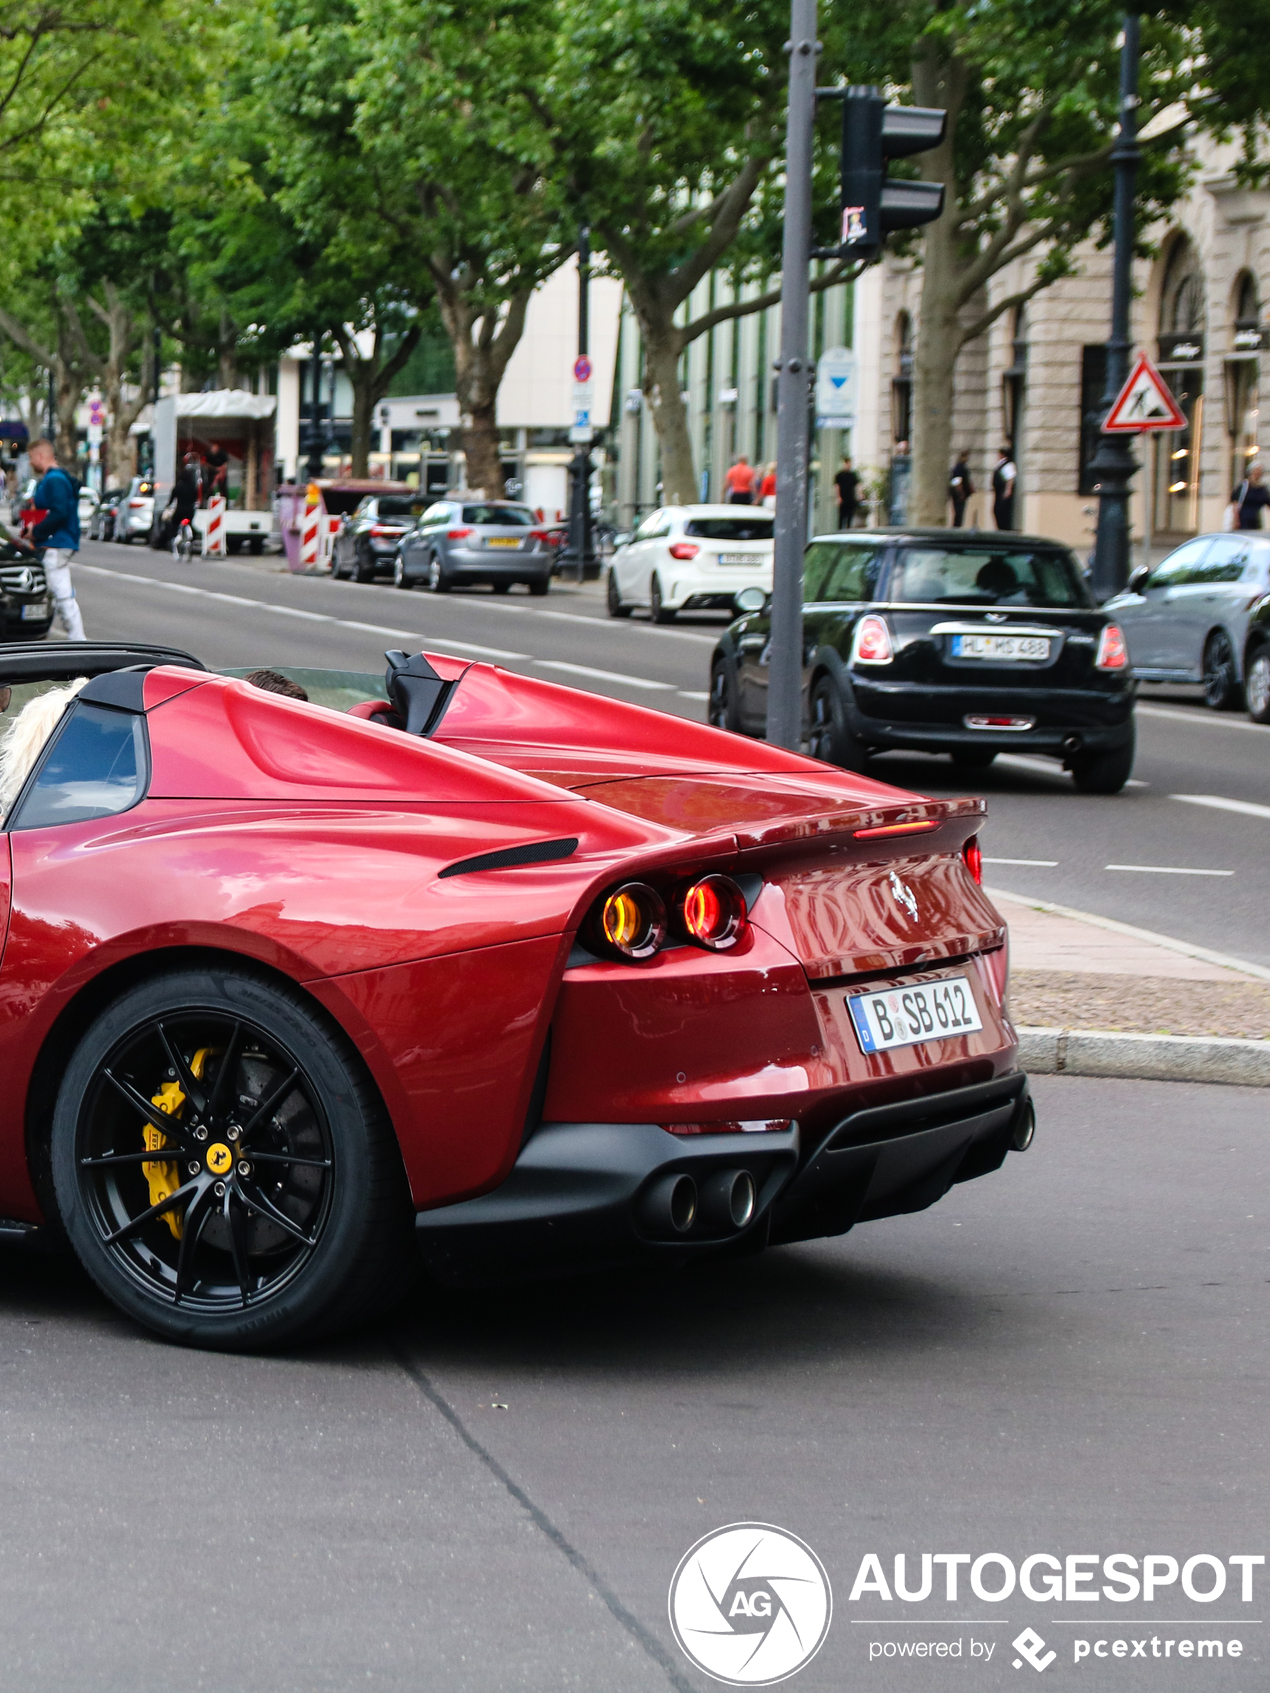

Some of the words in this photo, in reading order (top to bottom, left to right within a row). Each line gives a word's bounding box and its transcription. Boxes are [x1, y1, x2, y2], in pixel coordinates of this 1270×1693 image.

[963, 638, 984, 653] HL
[872, 998, 894, 1041] B
[902, 991, 934, 1035] SB
[933, 985, 973, 1028] 612
[862, 1029, 870, 1043] D
